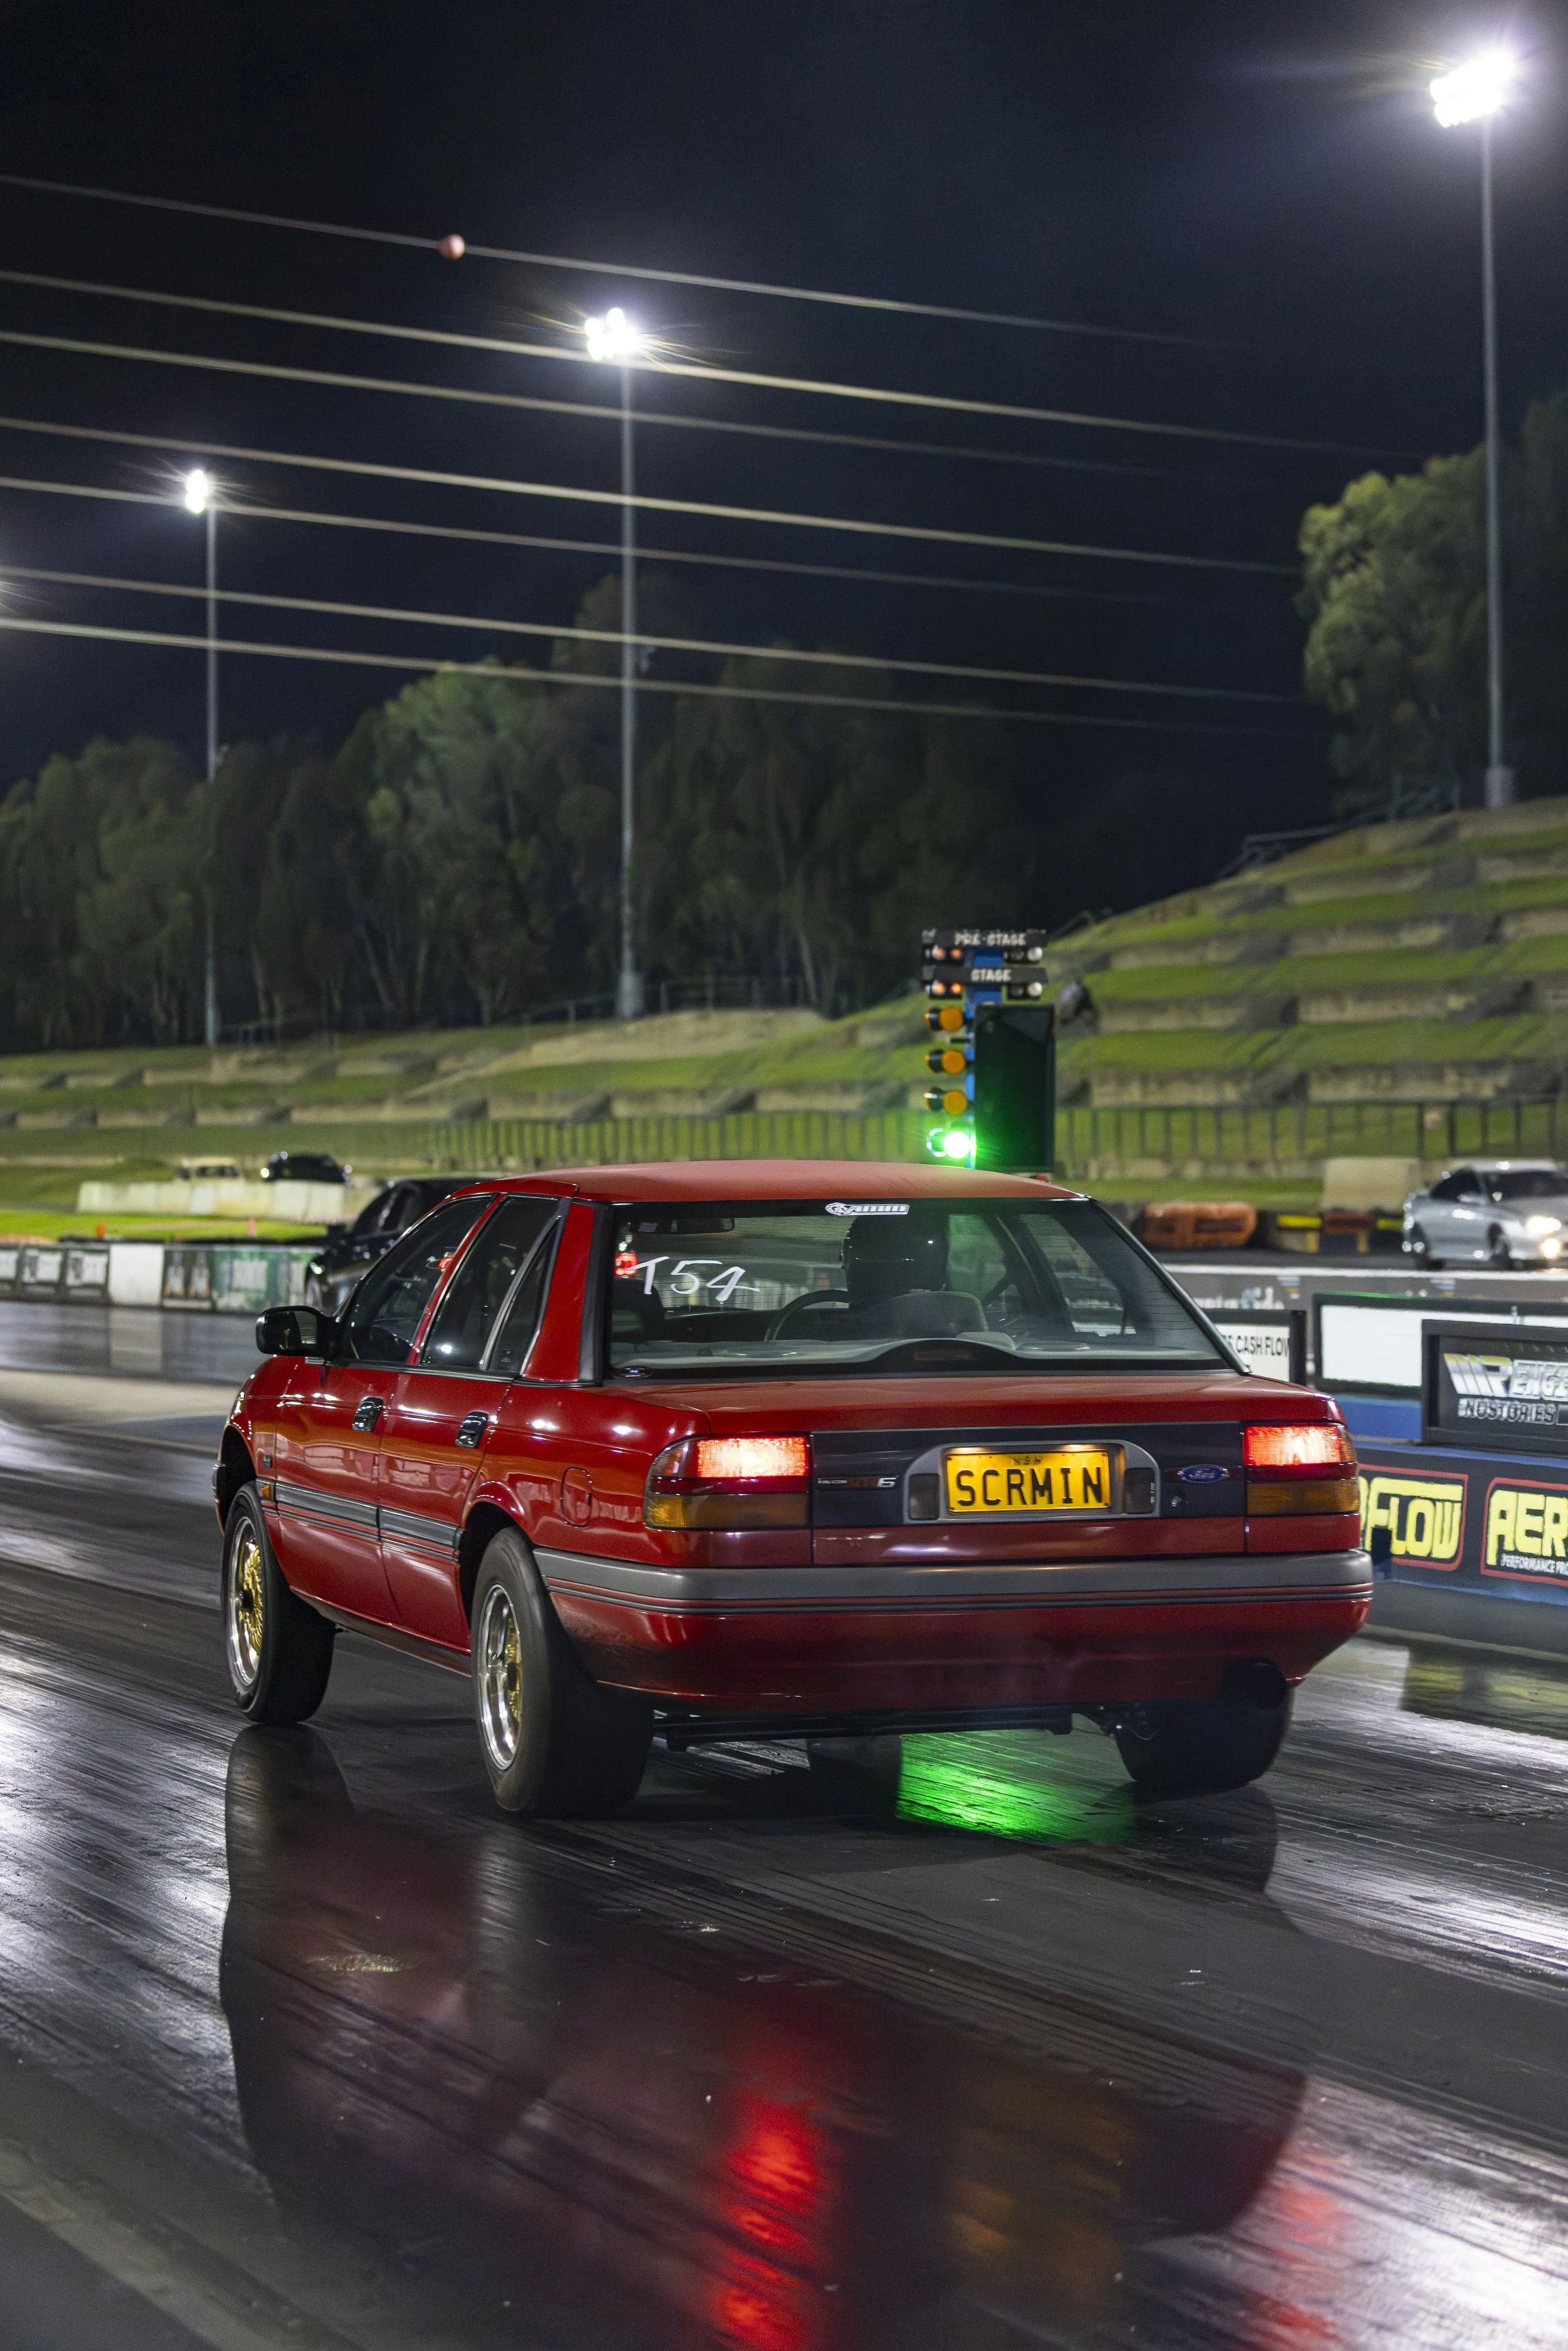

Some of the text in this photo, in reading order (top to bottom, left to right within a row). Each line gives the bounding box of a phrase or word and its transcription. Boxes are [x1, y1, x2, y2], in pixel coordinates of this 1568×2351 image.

[971, 969, 1012, 982] STAGE
[627, 1256, 761, 1304] T54
[1236, 1335, 1263, 1355] CASH
[956, 1467, 1103, 1506] SCRMIN
